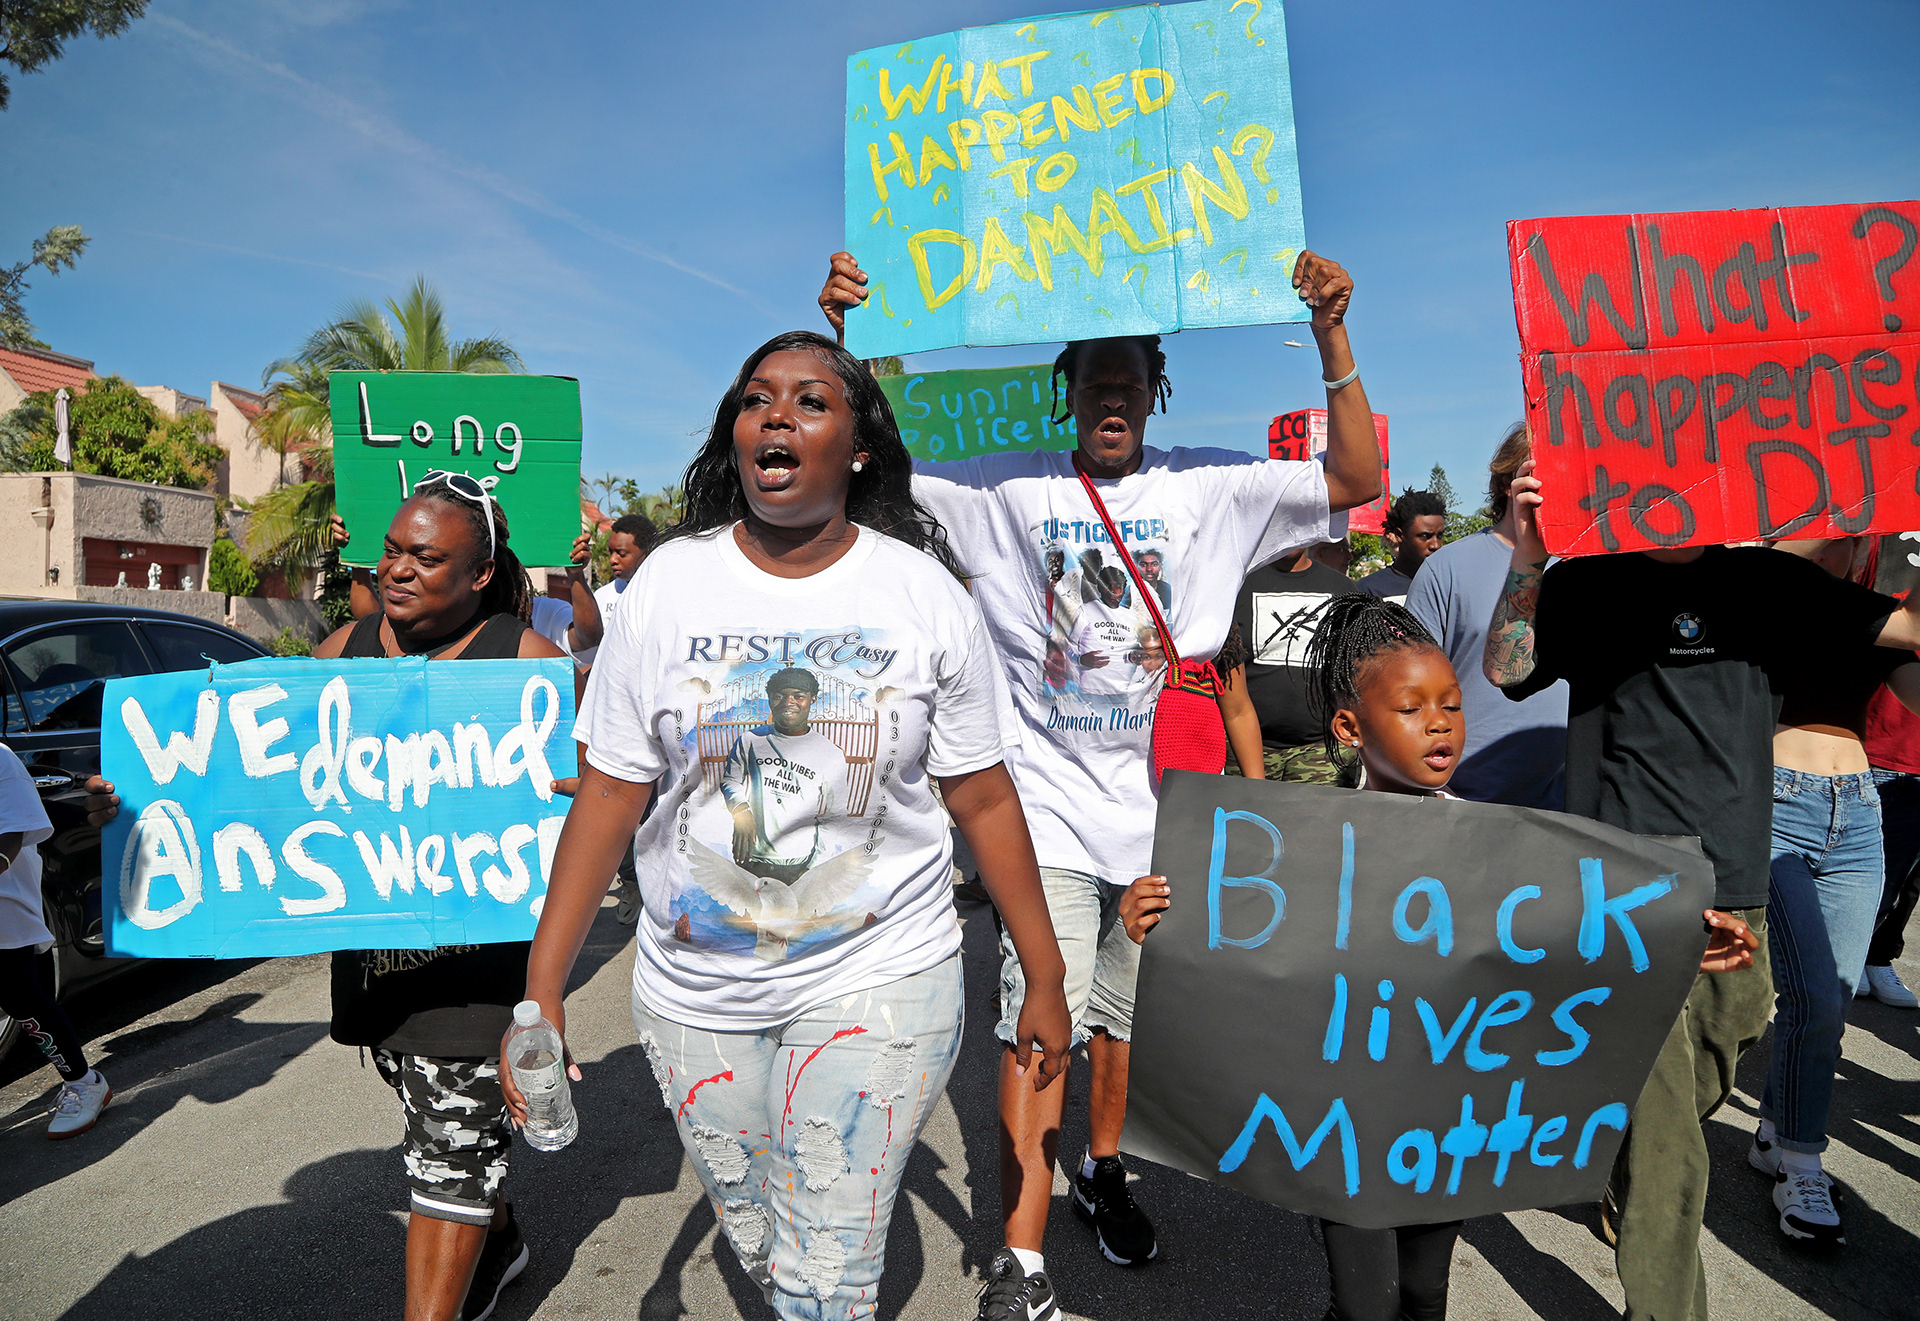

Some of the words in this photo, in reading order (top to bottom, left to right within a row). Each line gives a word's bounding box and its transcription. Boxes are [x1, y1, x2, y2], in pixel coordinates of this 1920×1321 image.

[879, 50, 1053, 121] WHAT
[868, 68, 1175, 202] HAPPENED
[989, 151, 1079, 198] TO
[1527, 221, 1819, 350] What
[359, 381, 523, 474] Long
[1539, 348, 1920, 468] happene
[1579, 464, 1696, 552] to
[1746, 422, 1891, 540] DJ
[685, 634, 801, 663] REST
[804, 632, 900, 679] Easy
[1669, 647, 1716, 656] Motorcycles
[121, 684, 299, 785] WE
[300, 675, 560, 814] demand
[756, 758, 788, 768] GOOD
[790, 761, 816, 780] VIBES
[764, 777, 780, 789] THE
[782, 781, 801, 795] WAY
[776, 769, 792, 781] ALL
[1207, 807, 1680, 973] Black
[1322, 972, 1612, 1073] lives
[1218, 1079, 1629, 1197] Matter
